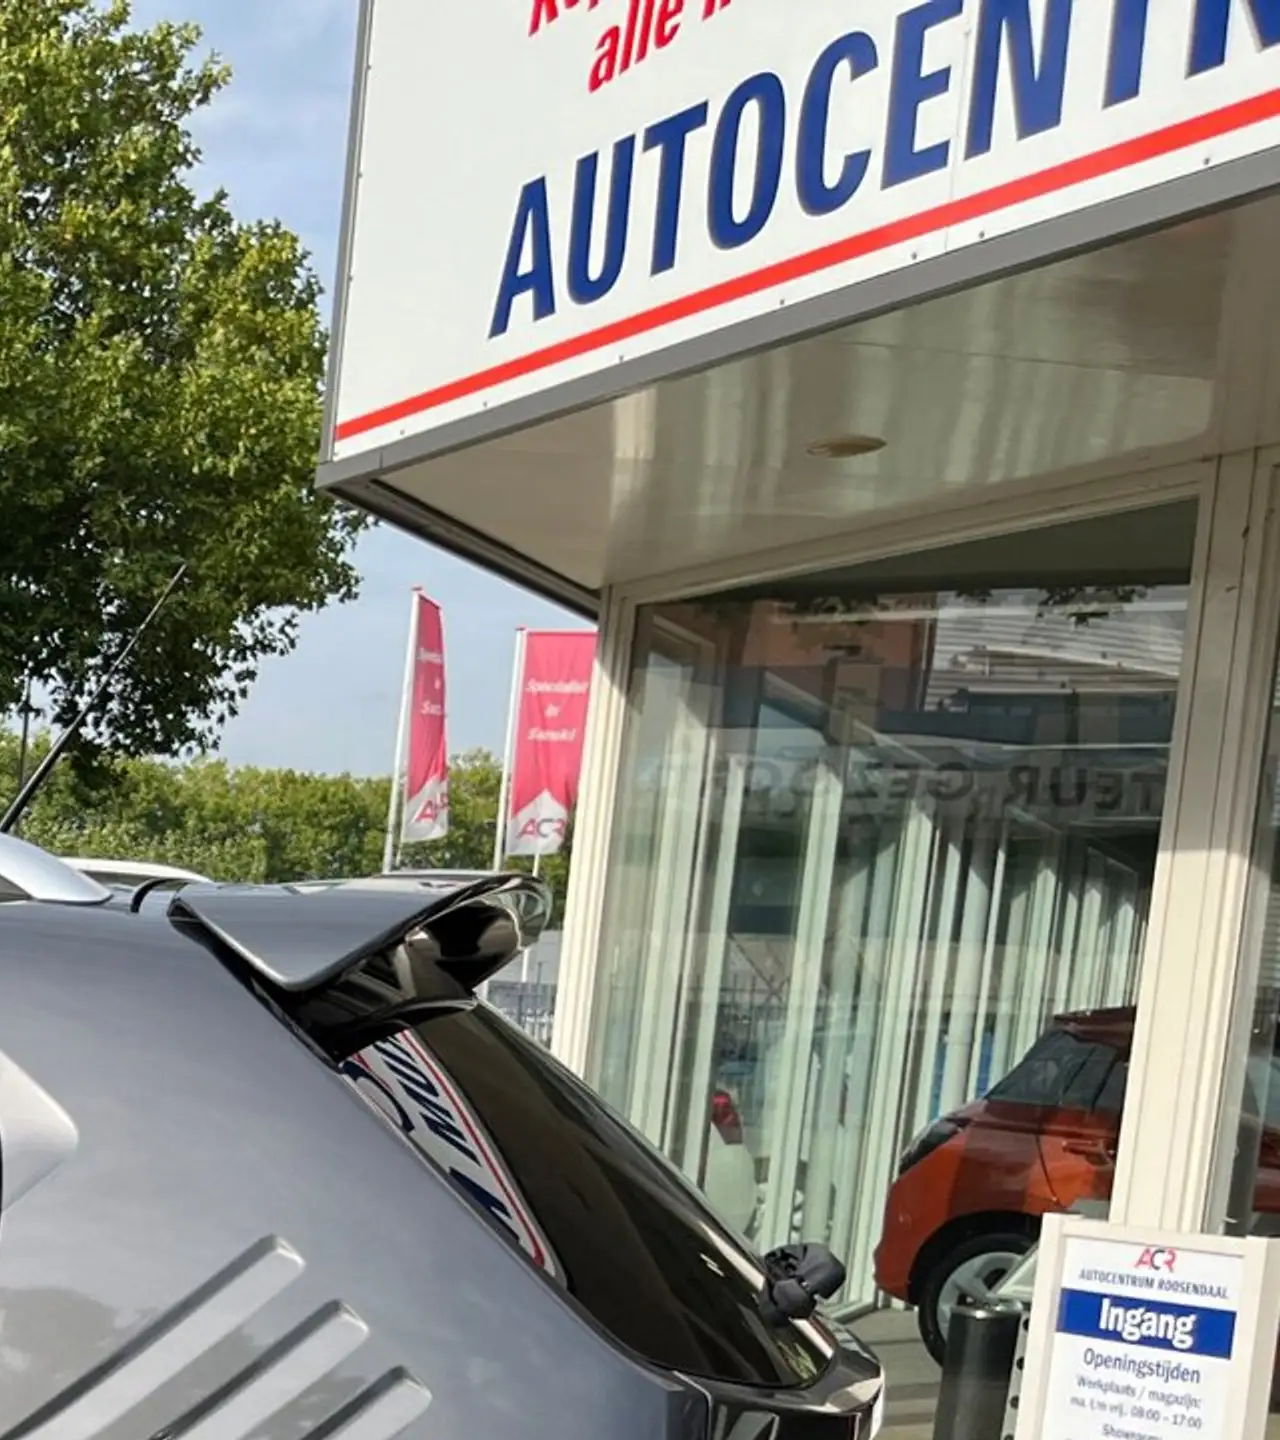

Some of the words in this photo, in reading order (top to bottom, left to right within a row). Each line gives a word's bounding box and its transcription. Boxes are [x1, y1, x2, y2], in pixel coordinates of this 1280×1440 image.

[588, 0, 686, 92] alle
[1134, 1247, 1177, 1272] ACR
[1078, 1269, 1155, 1289] AUTOCENTRUM
[1157, 1278, 1229, 1299] ROOSENDAAL
[1098, 1297, 1198, 1350] Ingang
[1083, 1347, 1201, 1384] Openingstijden
